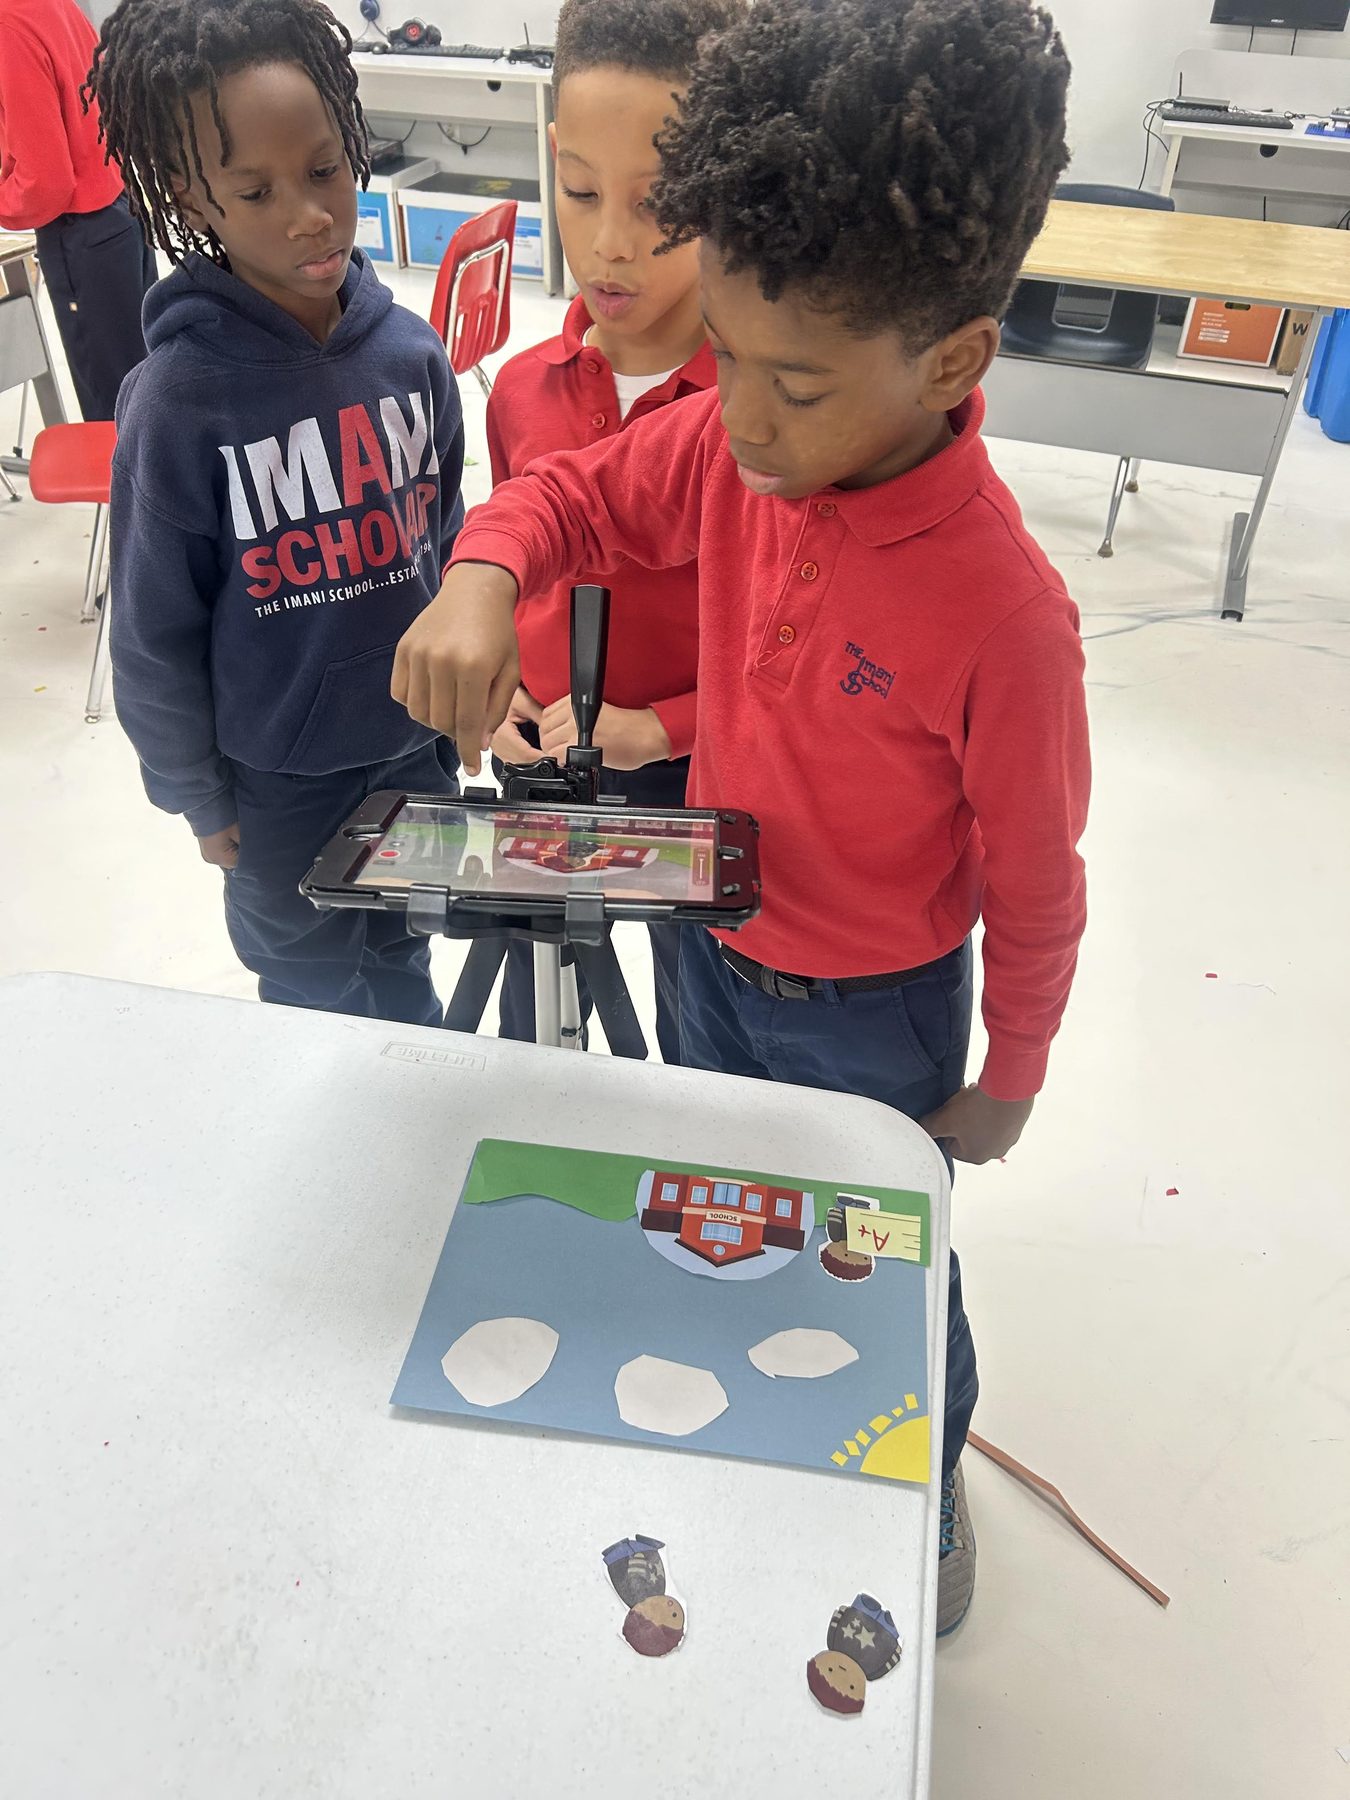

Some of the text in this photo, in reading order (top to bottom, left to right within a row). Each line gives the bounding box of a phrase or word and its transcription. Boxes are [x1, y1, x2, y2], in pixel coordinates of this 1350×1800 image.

[217, 391, 440, 540] IMANI
[254, 600, 281, 618] THE
[283, 590, 326, 609] IMANI
[845, 641, 864, 659] THE
[709, 1212, 738, 1222] SCHOOL
[857, 1224, 890, 1252] A+
